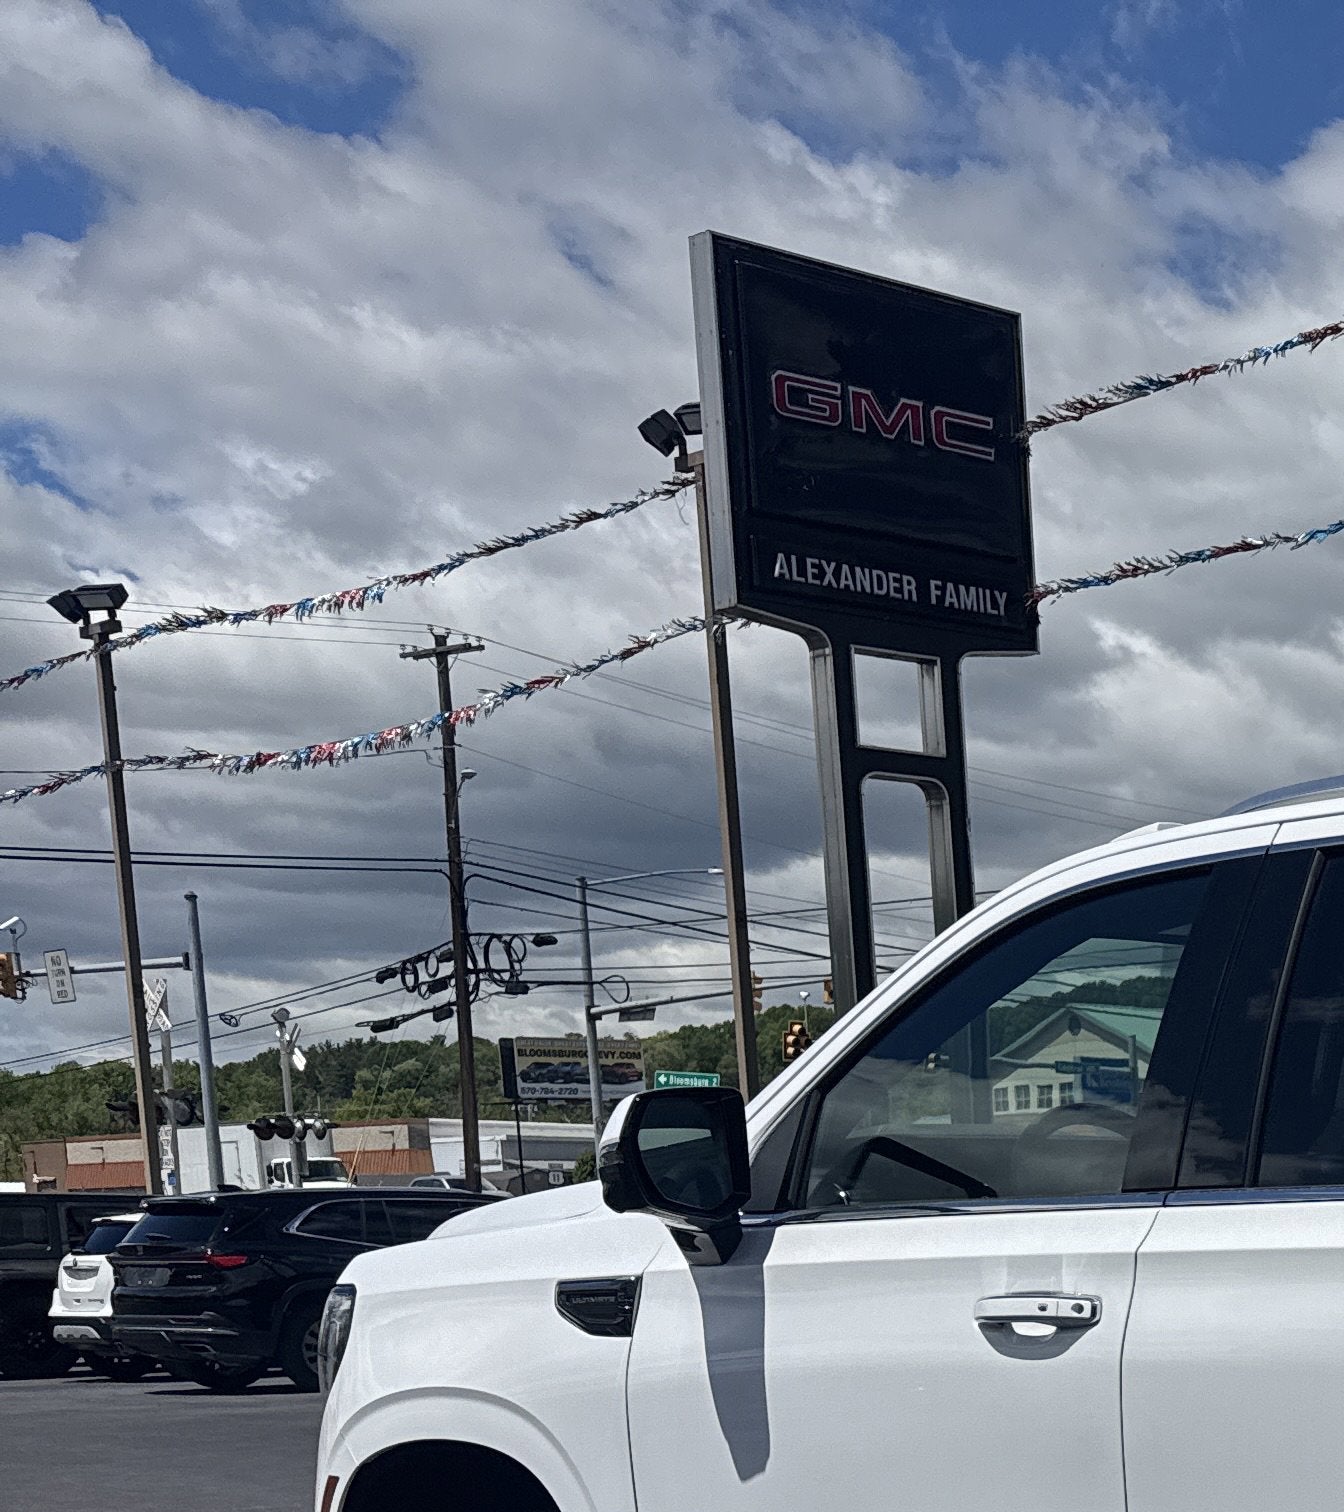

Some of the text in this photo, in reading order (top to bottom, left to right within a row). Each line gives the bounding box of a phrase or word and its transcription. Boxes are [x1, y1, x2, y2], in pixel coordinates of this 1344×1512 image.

[771, 370, 995, 461] GMC
[773, 552, 1008, 617] ALEXANDER FAMILY
[50, 955, 62, 967] NO
[57, 989, 69, 999] RED
